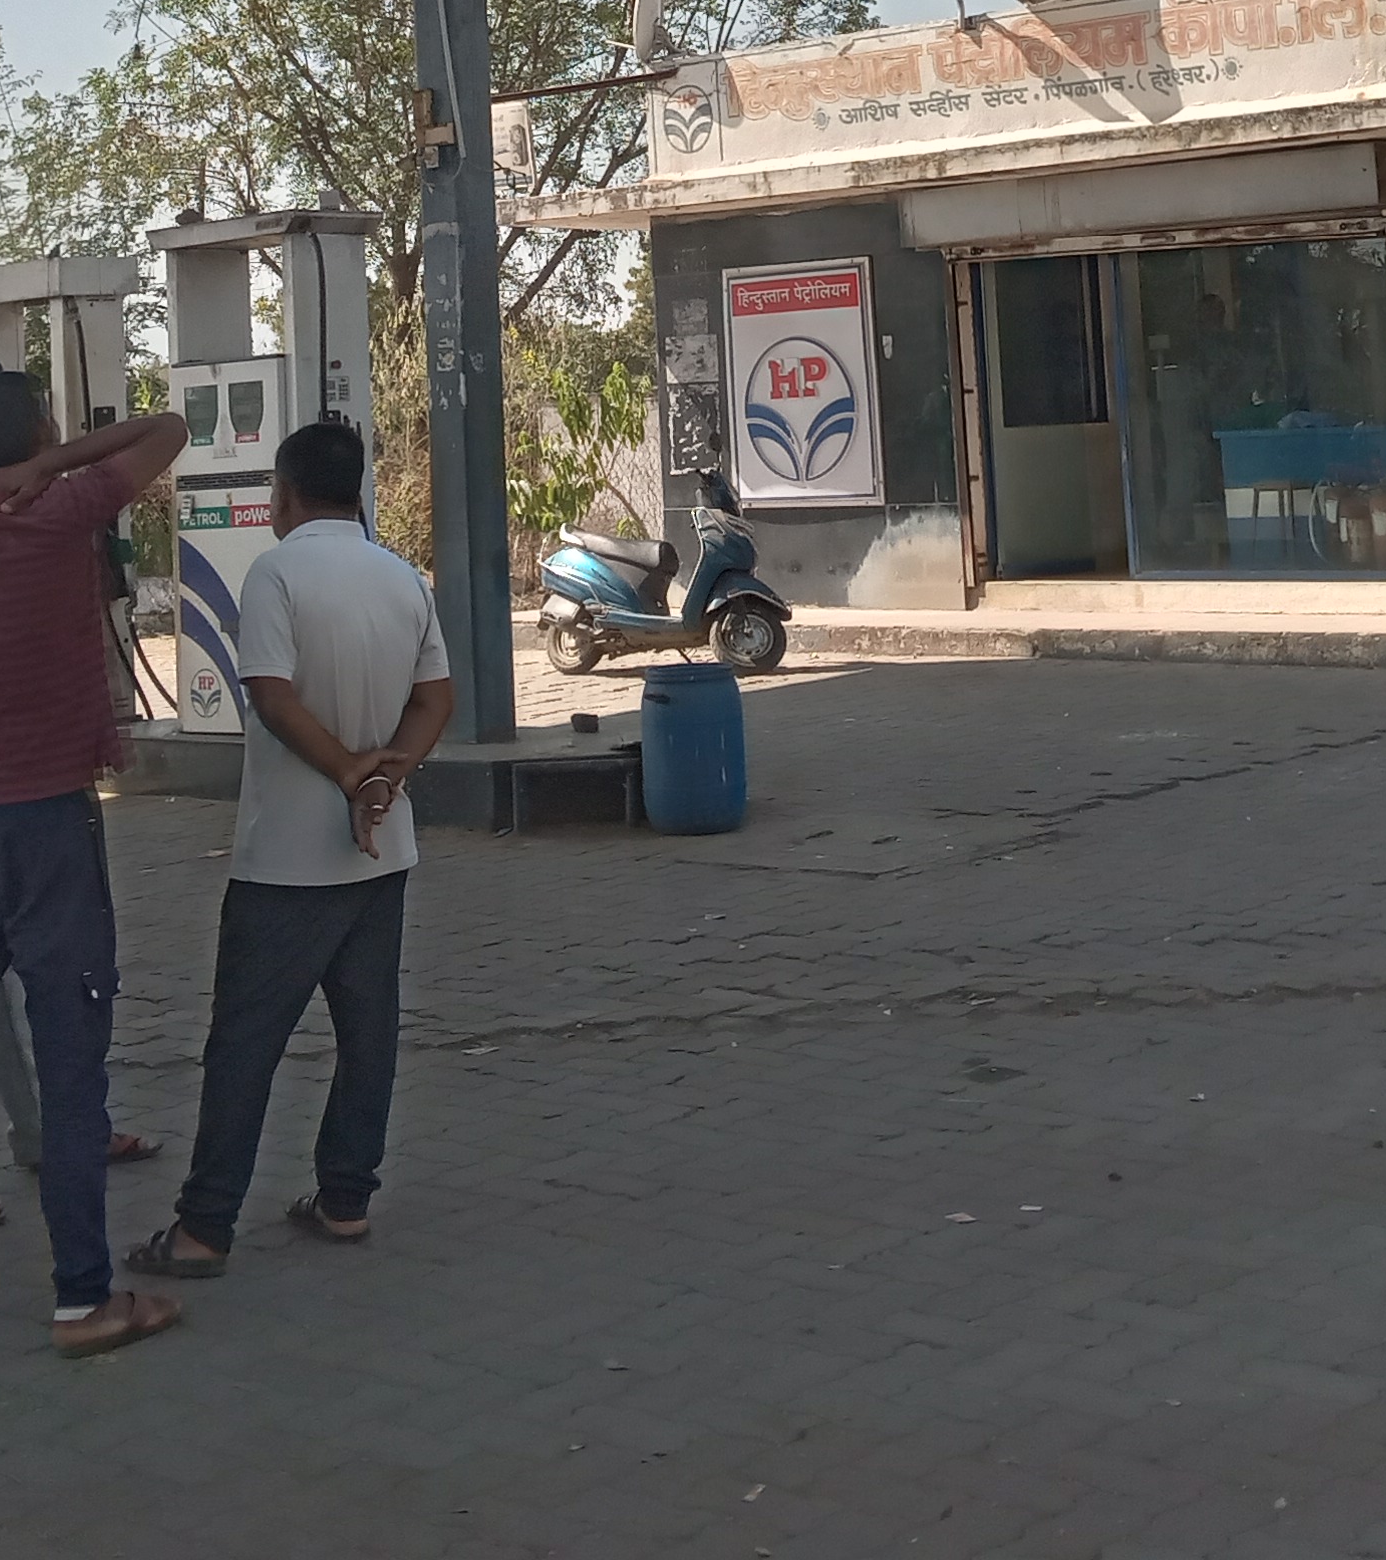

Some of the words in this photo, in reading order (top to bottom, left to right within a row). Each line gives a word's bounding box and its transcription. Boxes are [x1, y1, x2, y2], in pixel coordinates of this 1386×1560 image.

[839, 99, 901, 125] आशिष
[736, 287, 791, 311] हिन्दुस्तान
[793, 279, 852, 305] पेट्रोलियम
[768, 356, 829, 400] HP
[234, 506, 271, 526] poWe
[198, 676, 215, 690] HP
